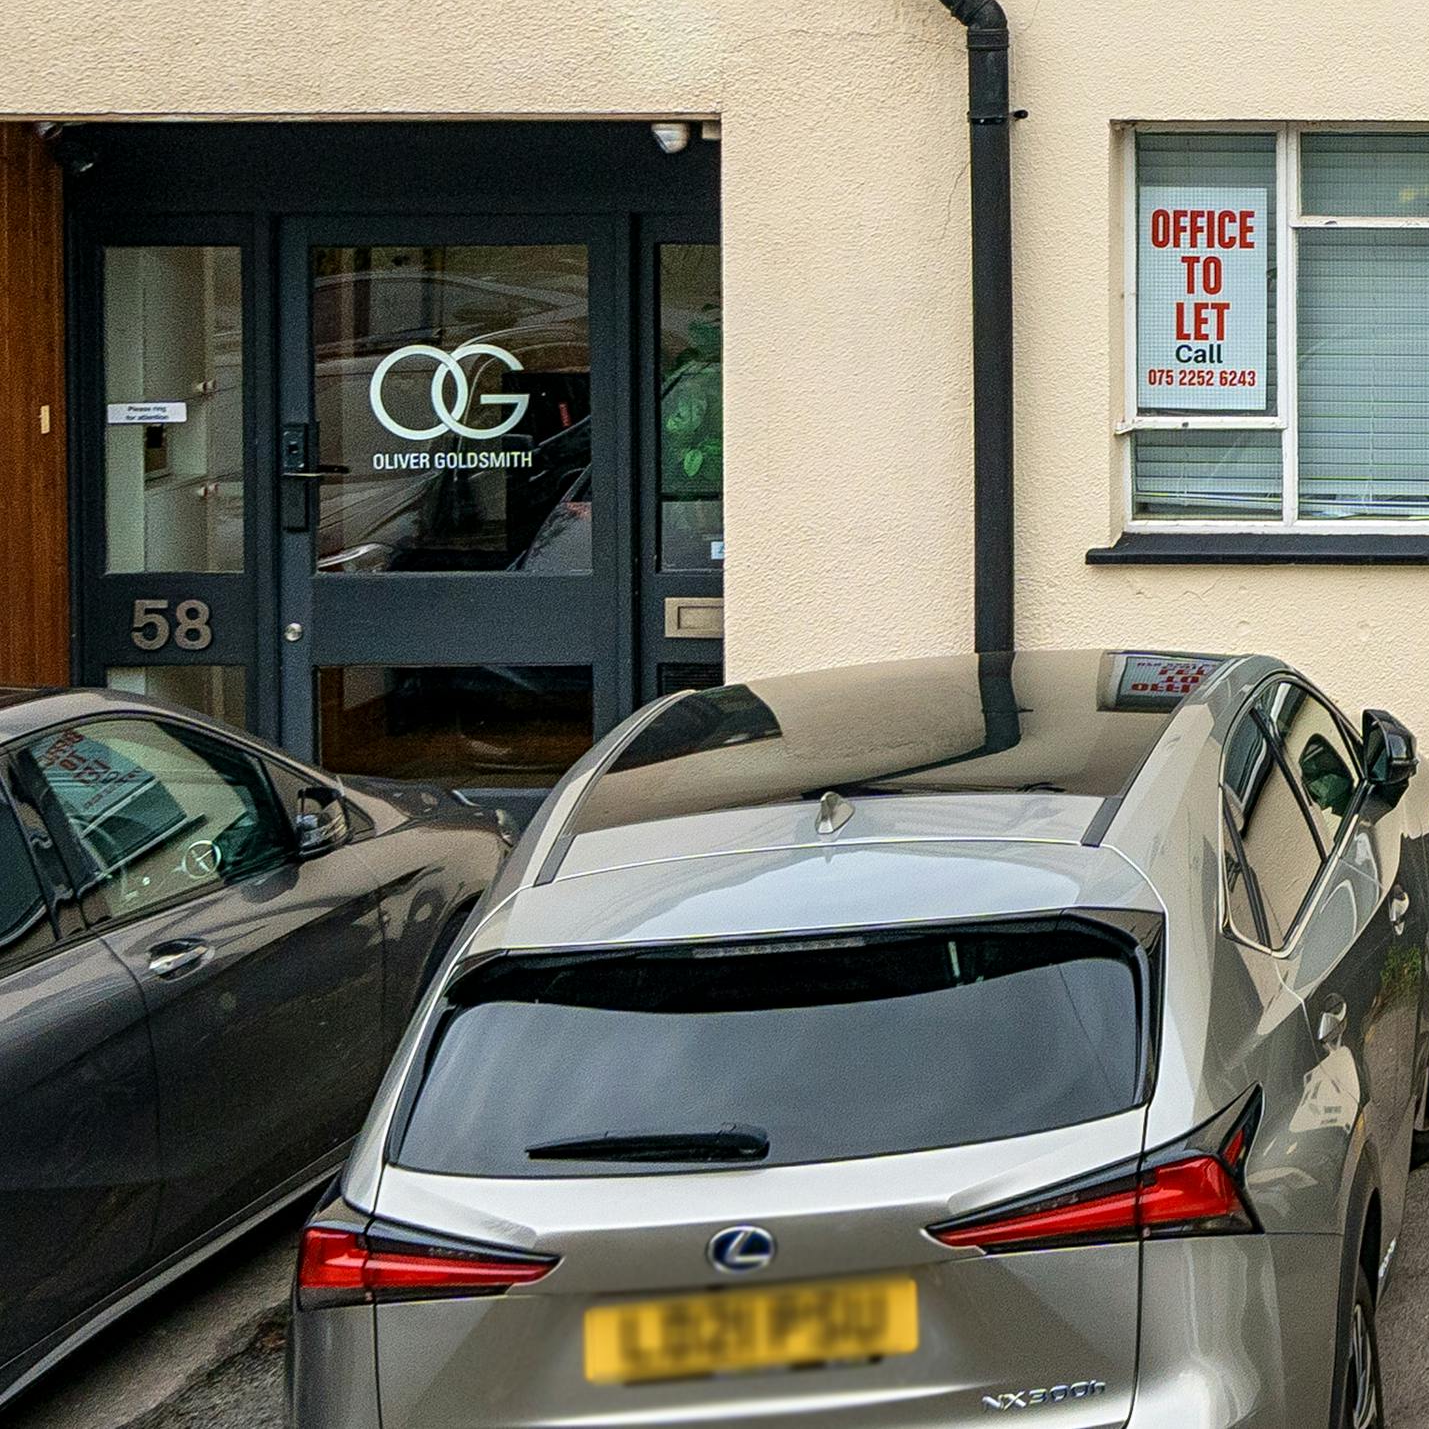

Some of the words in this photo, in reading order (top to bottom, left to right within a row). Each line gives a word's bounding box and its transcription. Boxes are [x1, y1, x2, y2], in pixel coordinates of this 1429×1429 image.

[1151, 209, 1255, 249] OFFICE
[1181, 256, 1222, 294] TO
[1175, 302, 1230, 341] LET
[1175, 344, 1223, 364] Call
[370, 344, 530, 440] OG
[1148, 369, 1174, 386] 075
[1179, 370, 1214, 387] 2252
[1220, 370, 1256, 387] 6243
[373, 453, 430, 469] OLIVER
[435, 452, 532, 468] GOLDSMITH
[131, 599, 212, 650] 58
